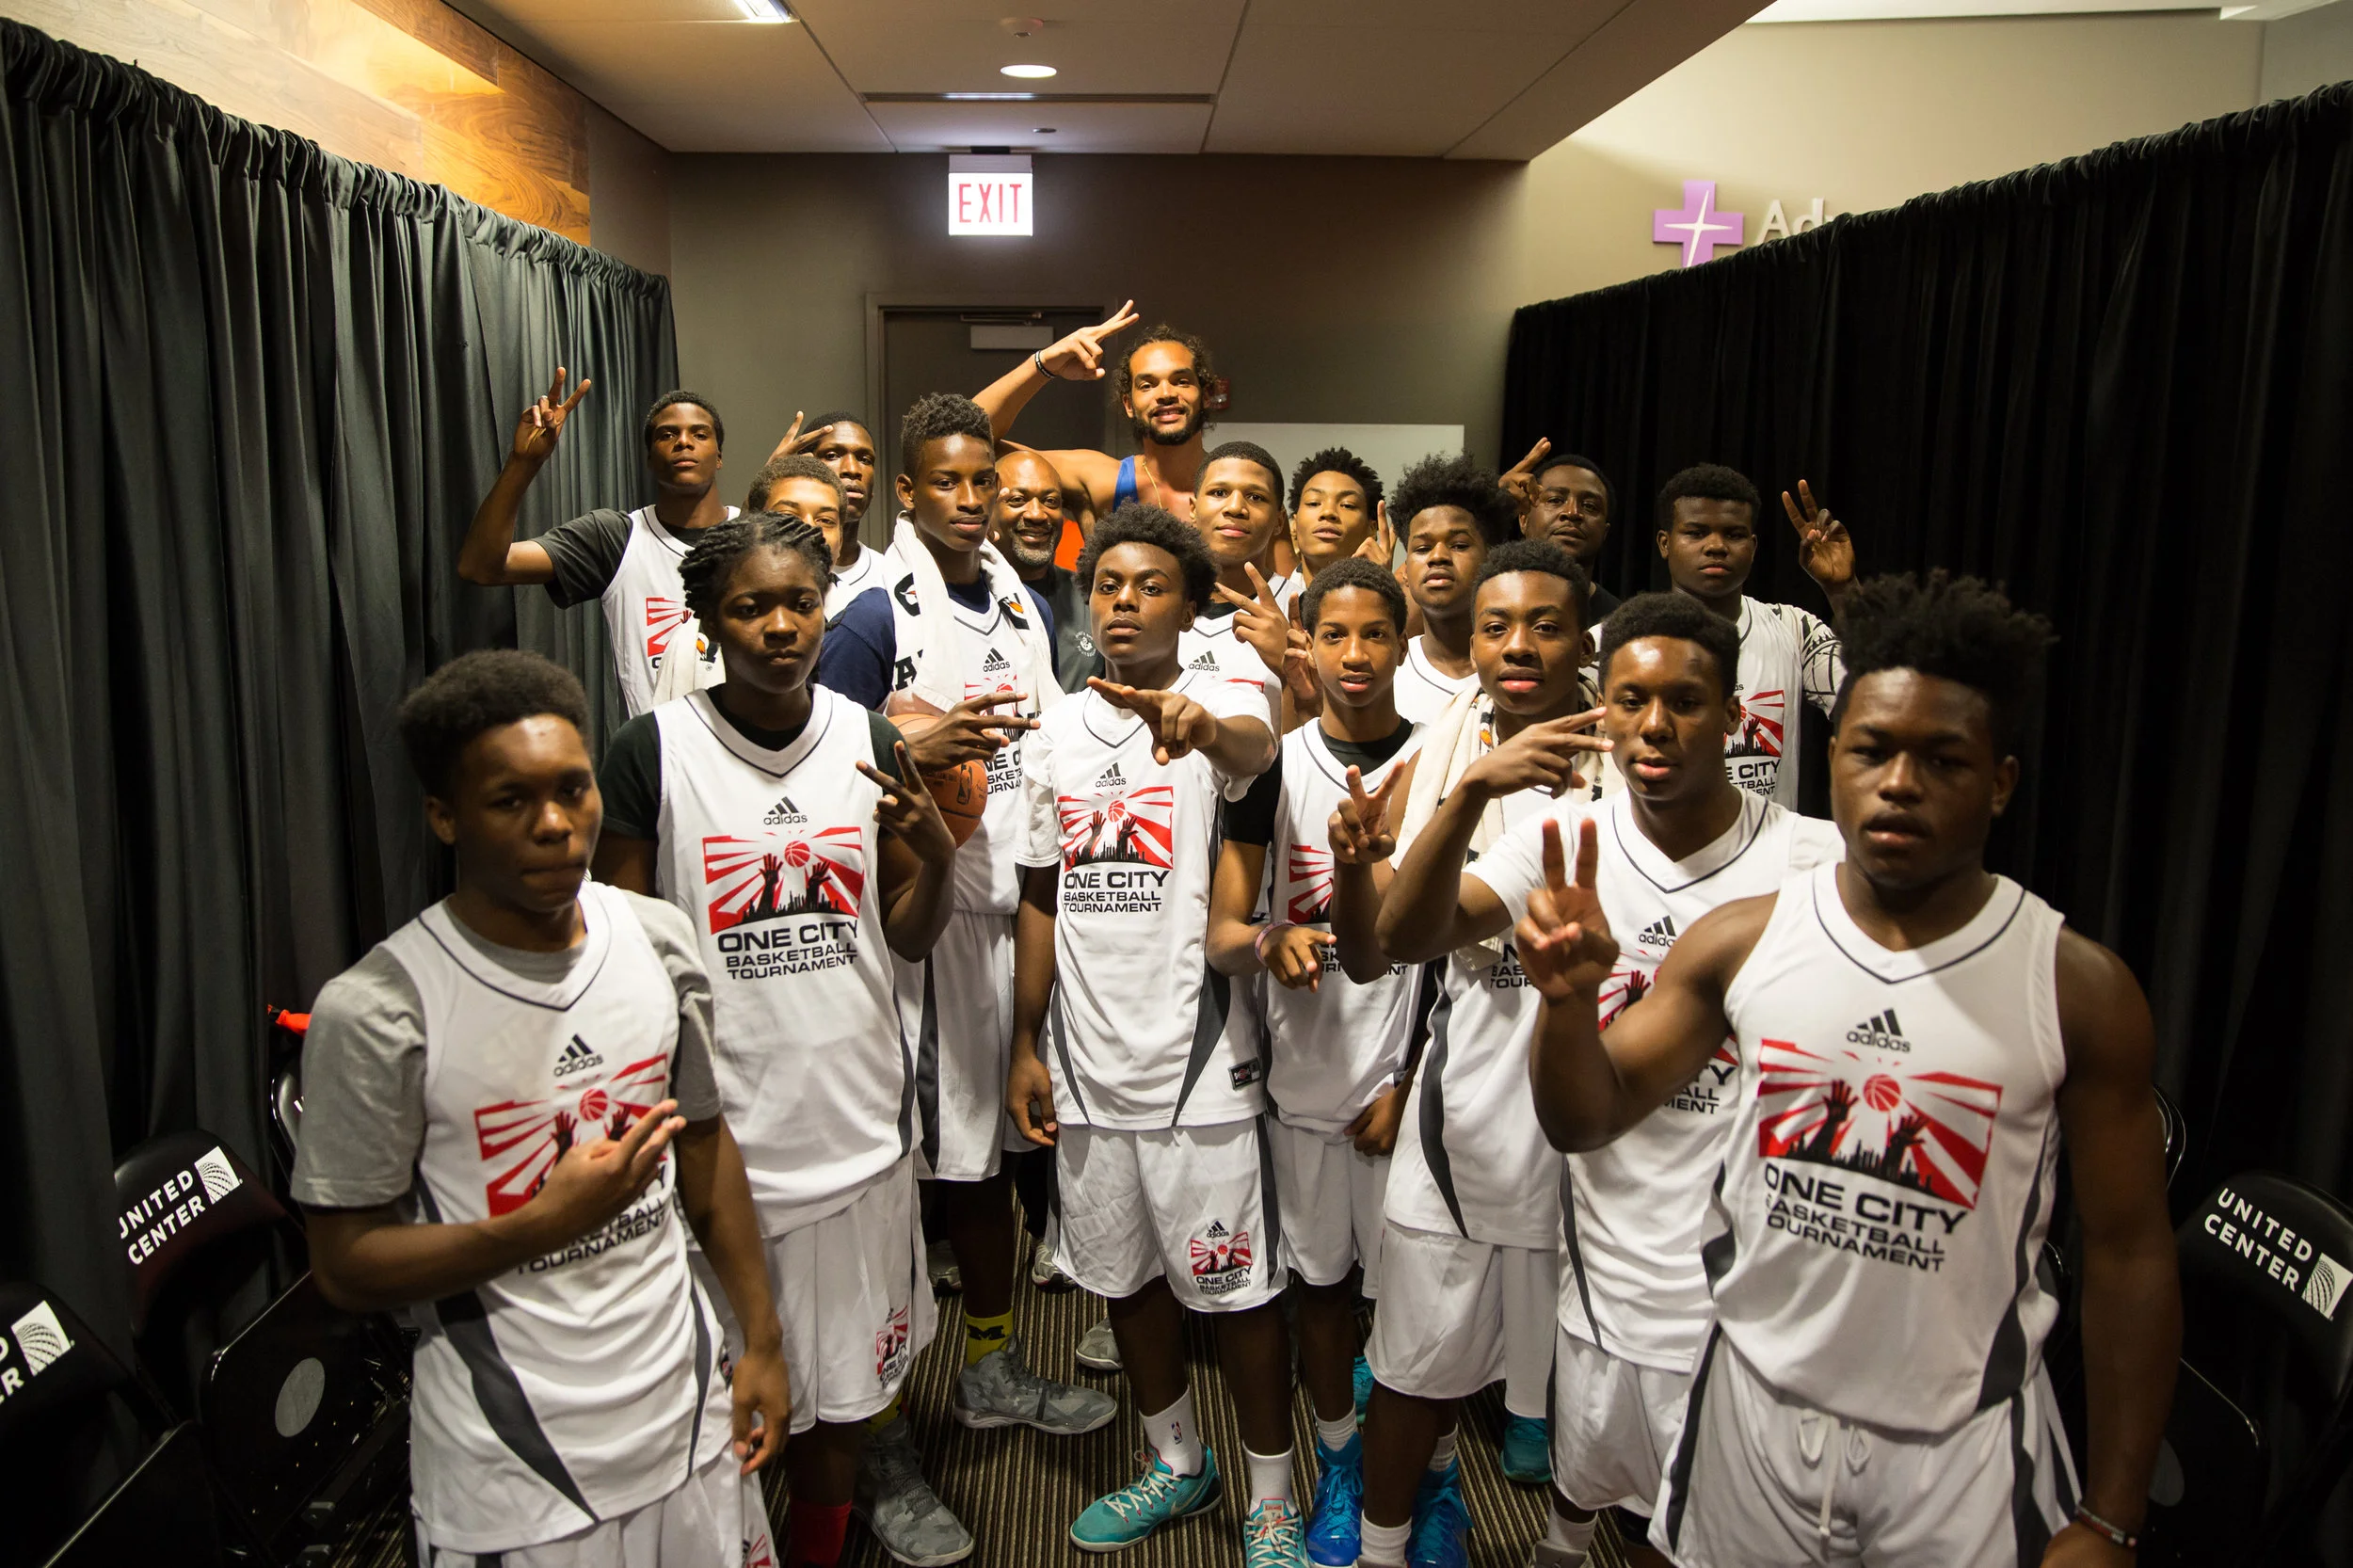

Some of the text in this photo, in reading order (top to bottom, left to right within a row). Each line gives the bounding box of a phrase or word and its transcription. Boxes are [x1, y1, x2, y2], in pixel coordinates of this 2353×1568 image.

[958, 183, 1022, 223] EXIT
[983, 661, 1010, 673] adidas
[1188, 662, 1220, 672] adidas
[1737, 759, 1781, 778] CITY
[1095, 776, 1127, 788] adidas
[763, 812, 808, 825] adidas
[1064, 871, 1170, 889] ONE CITY
[1064, 890, 1161, 902] BASKETBALL
[1064, 903, 1161, 913] TOURNAMENT
[717, 920, 857, 952] ONE CITY
[726, 942, 857, 968] BASKETBALL
[727, 954, 857, 980] TOURNAMENT
[1847, 1031, 1911, 1053] adidas
[553, 1053, 603, 1077] adidas
[1764, 1162, 1968, 1235] ONE CITY
[128, 1195, 205, 1265] CENTER
[2217, 1188, 2313, 1262] UNITED
[2204, 1213, 2300, 1292] CENTER
